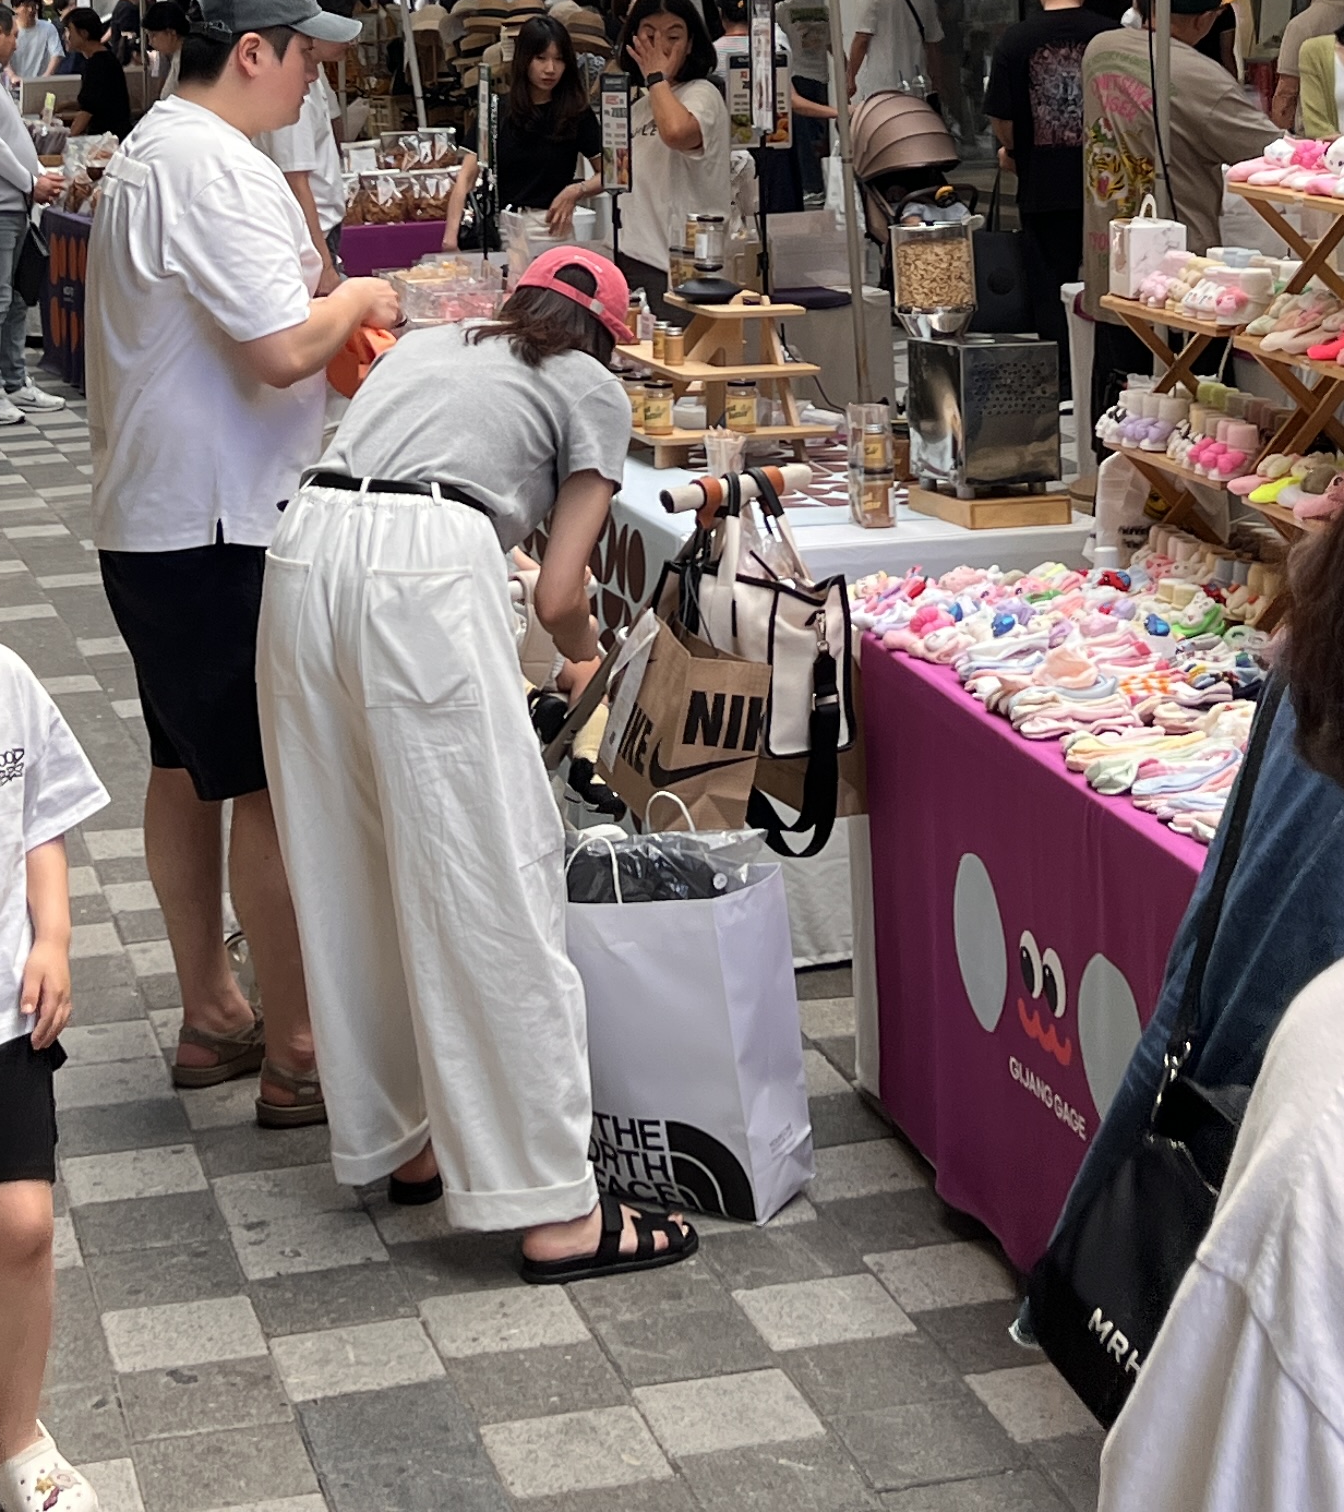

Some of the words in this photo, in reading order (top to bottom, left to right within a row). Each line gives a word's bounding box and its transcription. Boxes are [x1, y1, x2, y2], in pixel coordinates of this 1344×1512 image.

[1009, 1055, 1054, 1109] GIJANG
[1054, 1093, 1087, 1141] GAGE
[592, 1111, 665, 1152] THE
